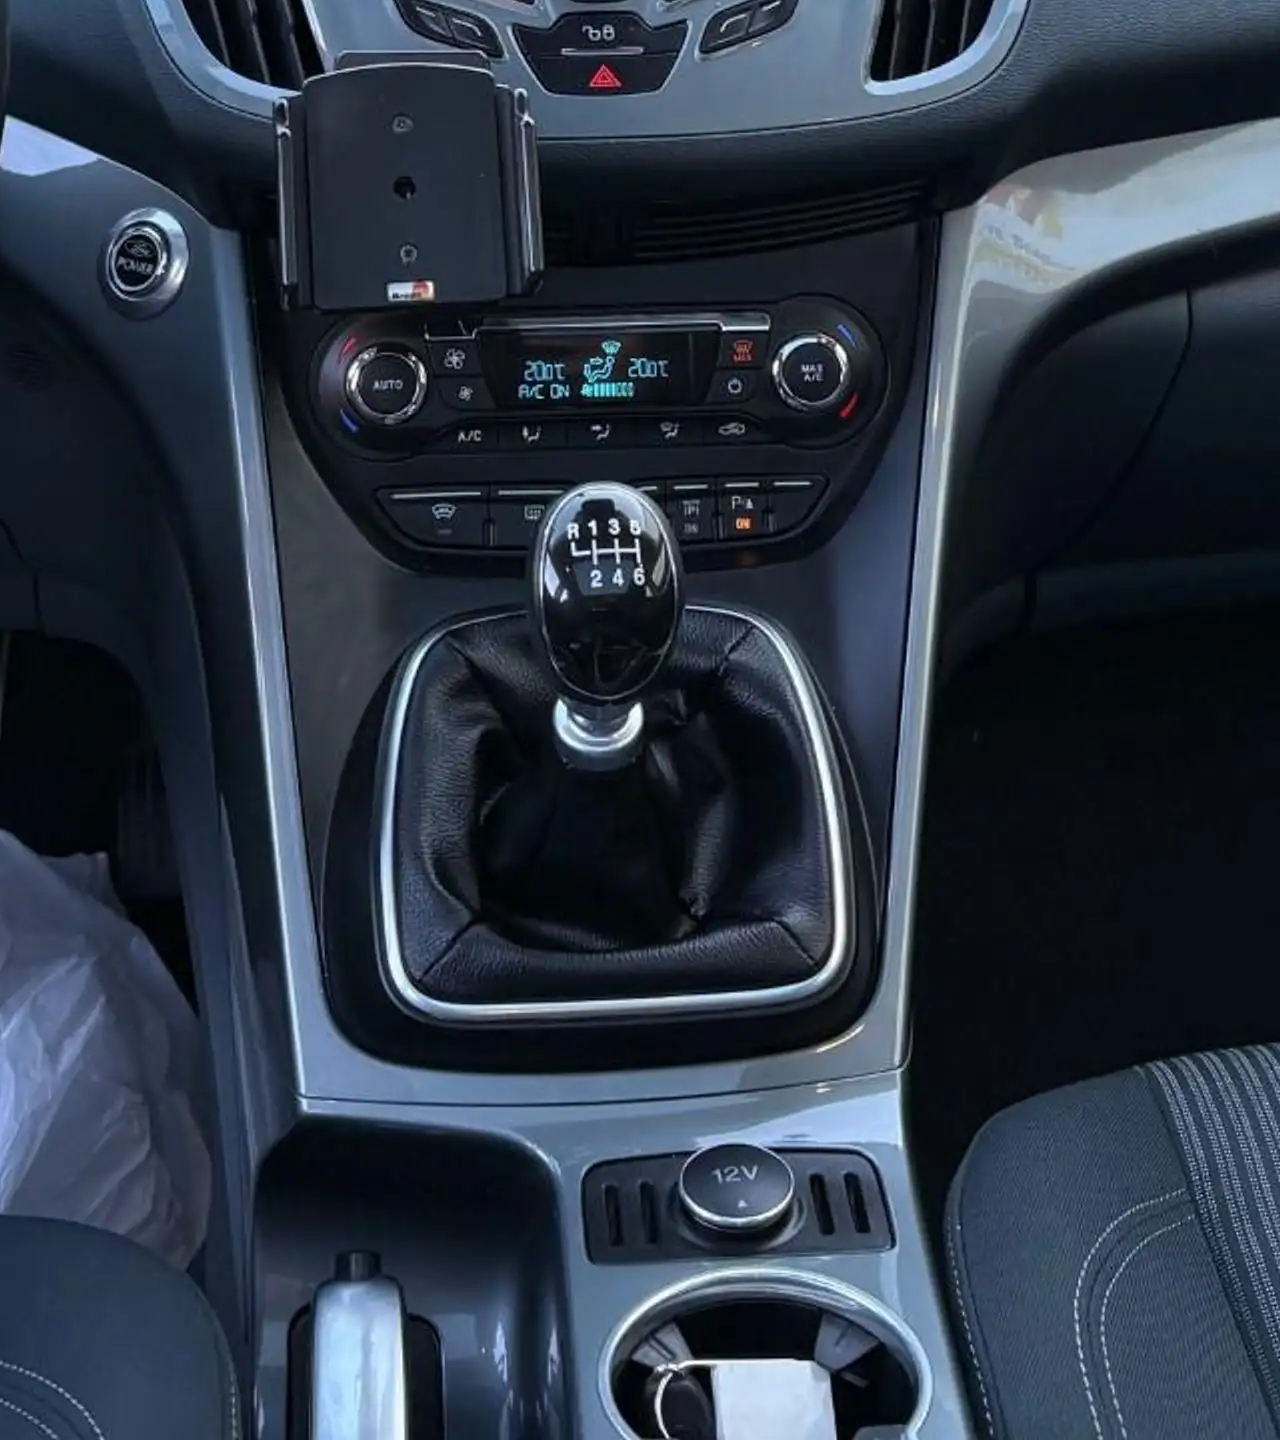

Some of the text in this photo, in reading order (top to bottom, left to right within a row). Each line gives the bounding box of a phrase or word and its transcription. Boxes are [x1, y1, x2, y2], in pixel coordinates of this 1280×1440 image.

[373, 379, 404, 391] AUTO
[518, 384, 570, 399] A/C ON
[458, 430, 482, 442] A/C
[567, 518, 642, 540] R 1 3 5
[735, 518, 751, 530] ON
[590, 567, 646, 588] 2 4 6
[711, 1165, 758, 1184] 12V
